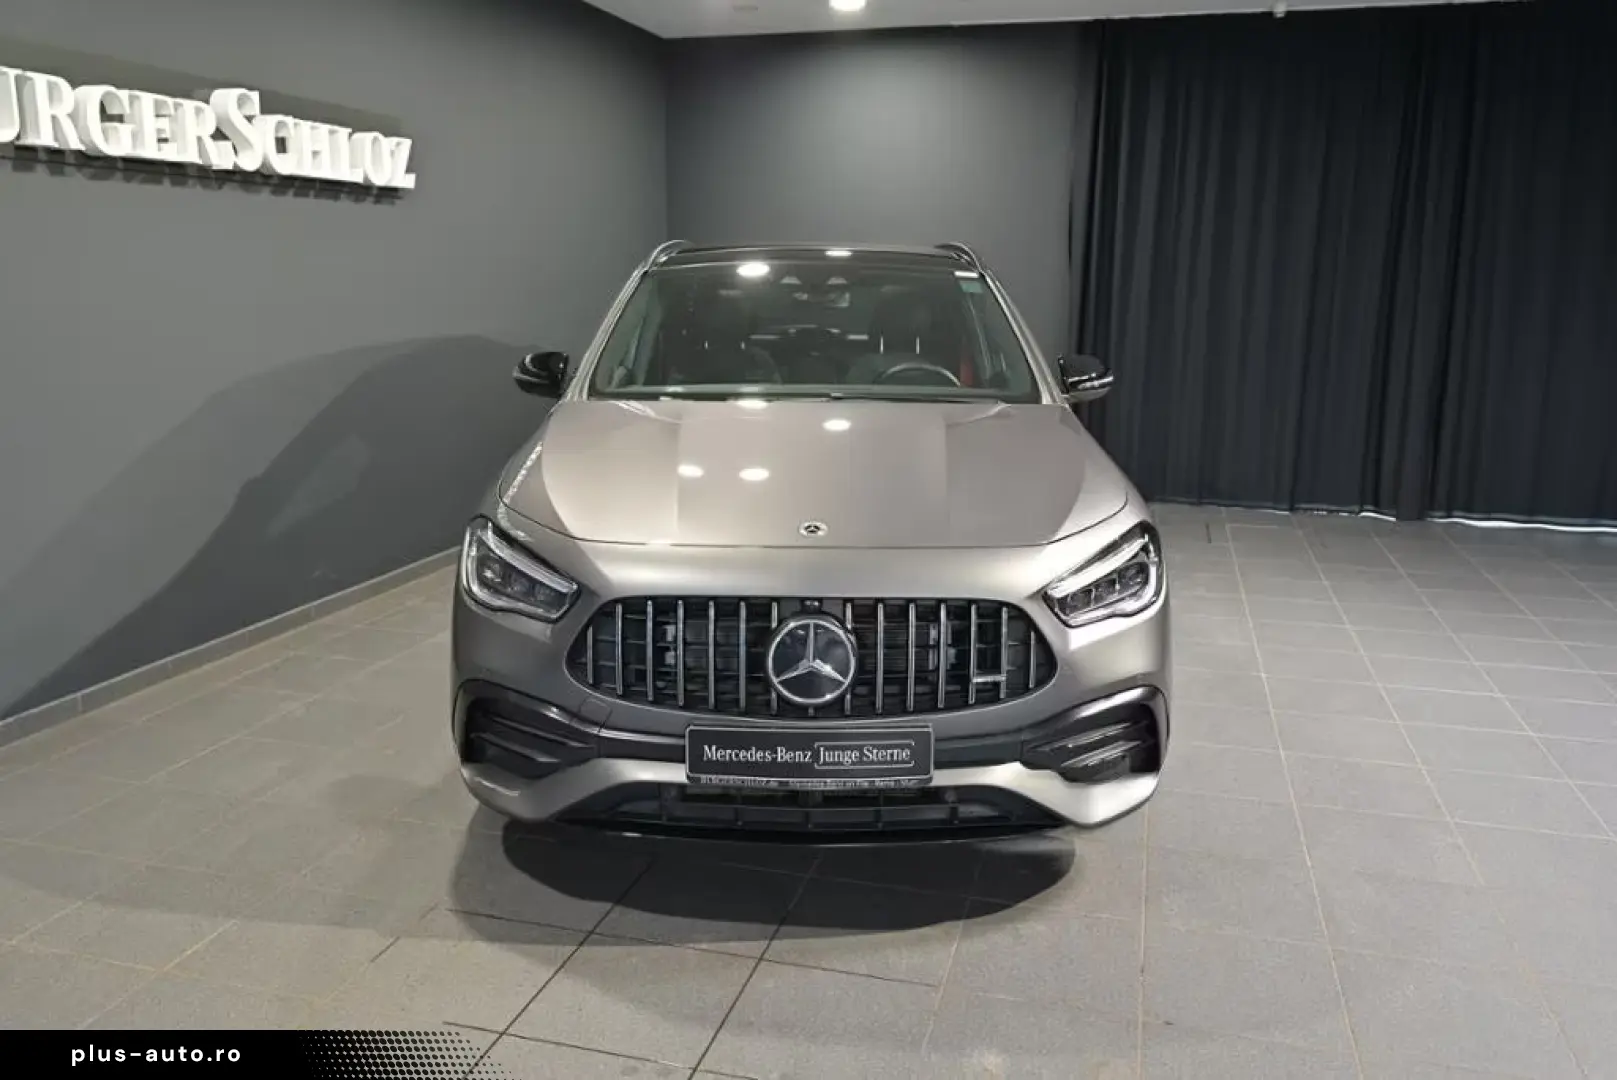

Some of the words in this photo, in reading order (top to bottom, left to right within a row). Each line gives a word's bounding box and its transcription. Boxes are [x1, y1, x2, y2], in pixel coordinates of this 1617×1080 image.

[703, 744, 812, 763] Mercedes-Benz
[819, 747, 860, 765] Junge
[863, 747, 911, 762] Sterne
